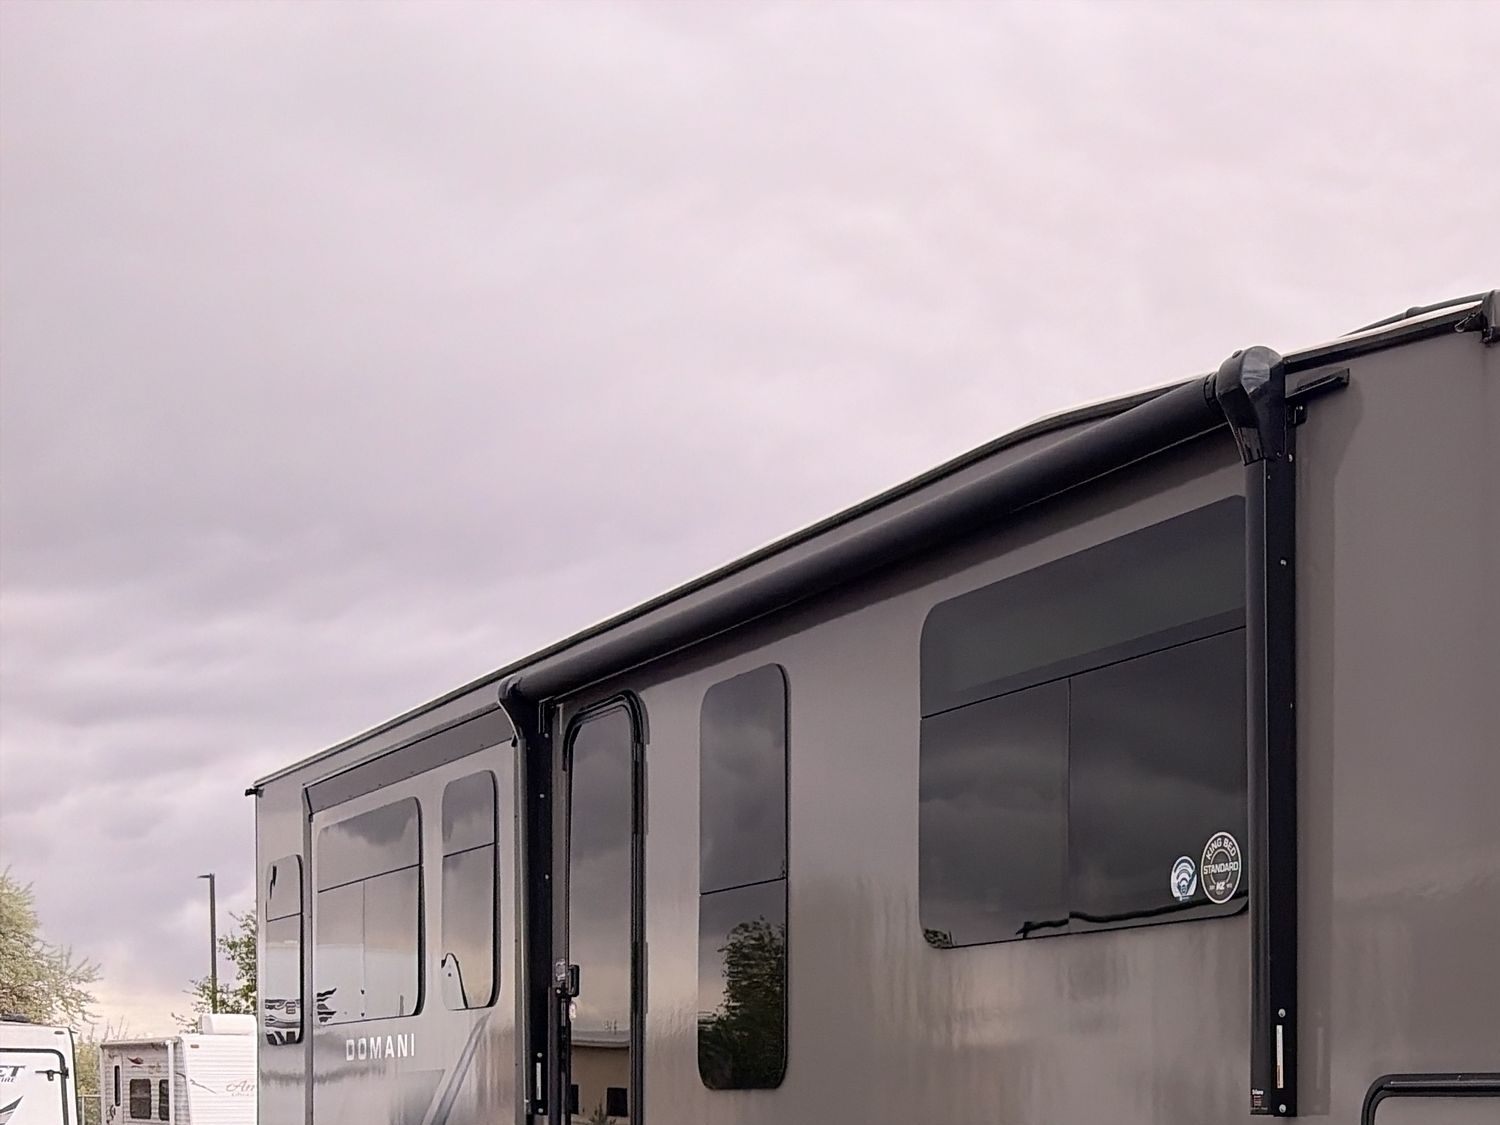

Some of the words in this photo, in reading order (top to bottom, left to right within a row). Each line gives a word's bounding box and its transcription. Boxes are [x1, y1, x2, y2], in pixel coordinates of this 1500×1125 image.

[1206, 838, 1222, 860] KING
[1223, 838, 1236, 857] BED
[1203, 861, 1239, 875] STANDARD
[346, 1033, 415, 1061] DOMANI
